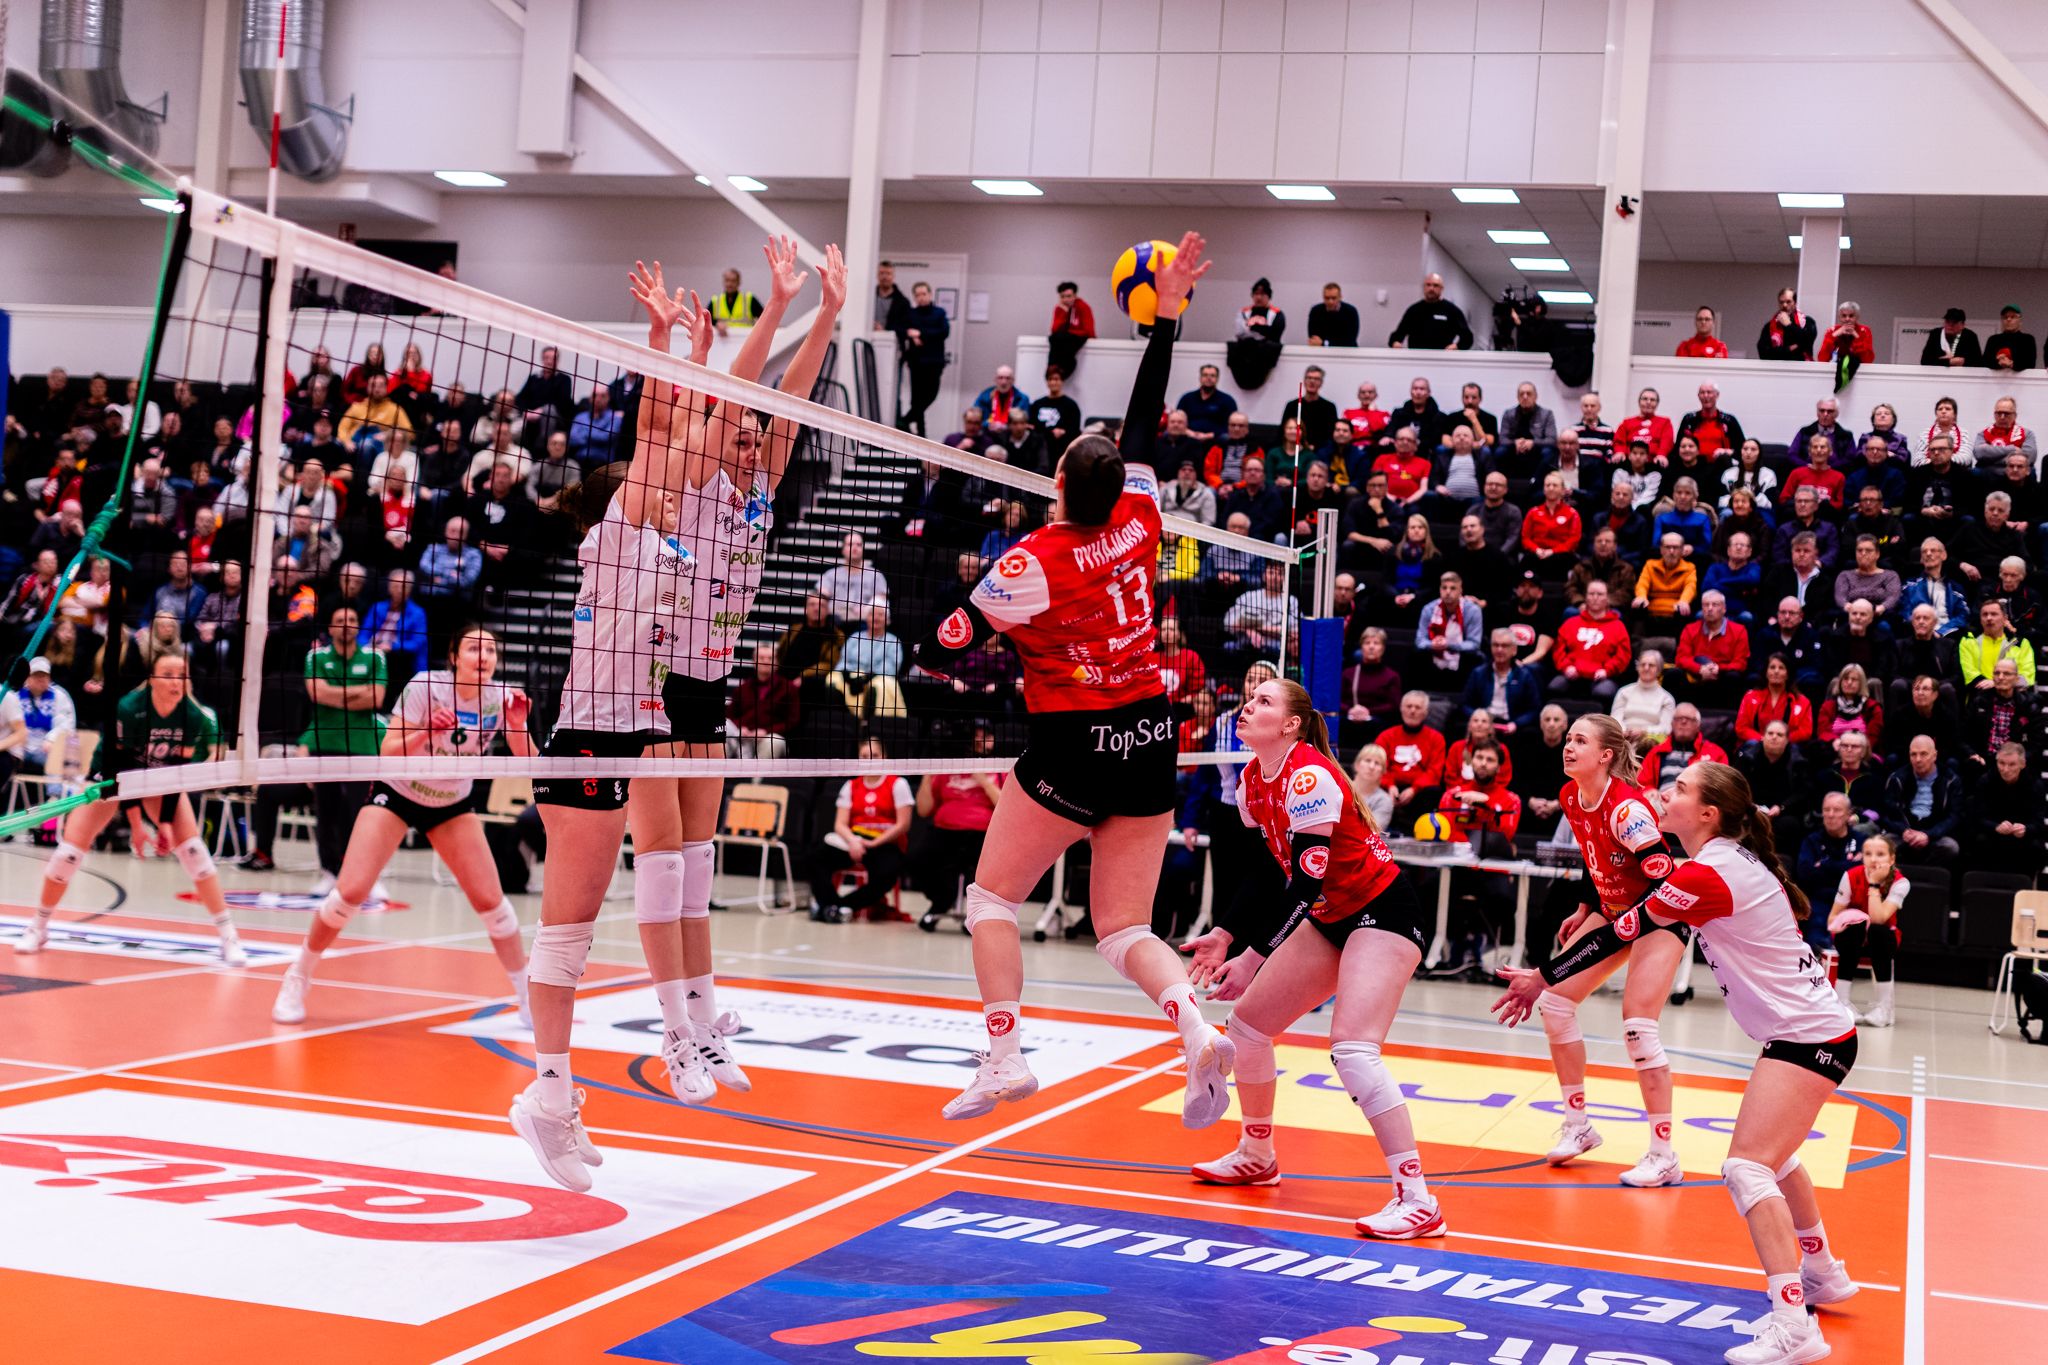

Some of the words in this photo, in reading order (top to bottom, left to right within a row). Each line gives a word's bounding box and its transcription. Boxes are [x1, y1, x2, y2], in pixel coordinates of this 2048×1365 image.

[1073, 518, 1148, 573] PYHÄJÄRVI
[1105, 565, 1151, 626] 13
[1090, 716, 1173, 760] TopSet
[1289, 798, 1327, 815] MALM
[1660, 884, 1691, 908] Atria
[1268, 901, 1309, 947] Palautuminen
[1552, 941, 1600, 975] Palautuminen
[898, 1206, 1772, 1336] MESTARUUSLIIGA
